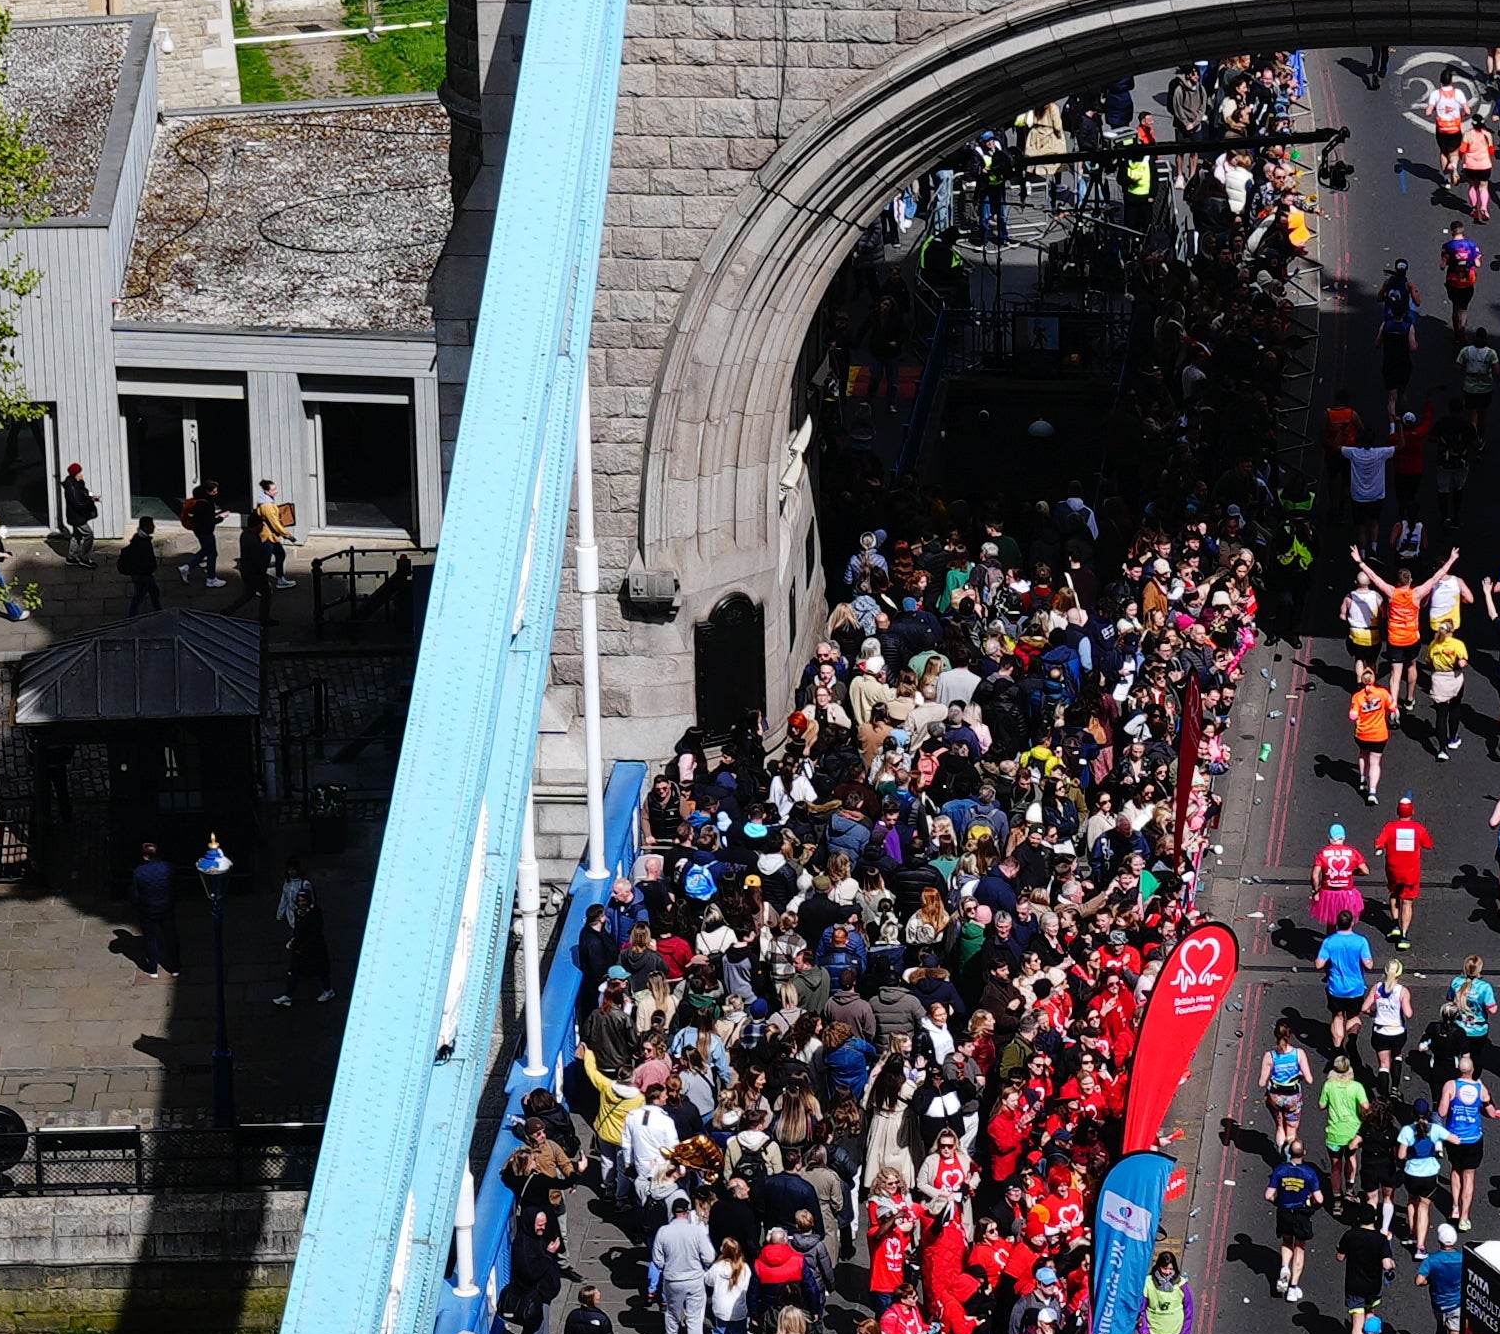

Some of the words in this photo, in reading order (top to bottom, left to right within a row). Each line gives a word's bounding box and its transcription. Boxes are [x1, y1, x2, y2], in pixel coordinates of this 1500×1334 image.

[1174, 997, 1195, 1007] British
[1196, 994, 1215, 1003] Heart
[1175, 1004, 1212, 1015] Foundation
[1110, 1239, 1126, 1269] UK
[1467, 1268, 1490, 1295] TATA
[1465, 1298, 1499, 1333] SERVICES
